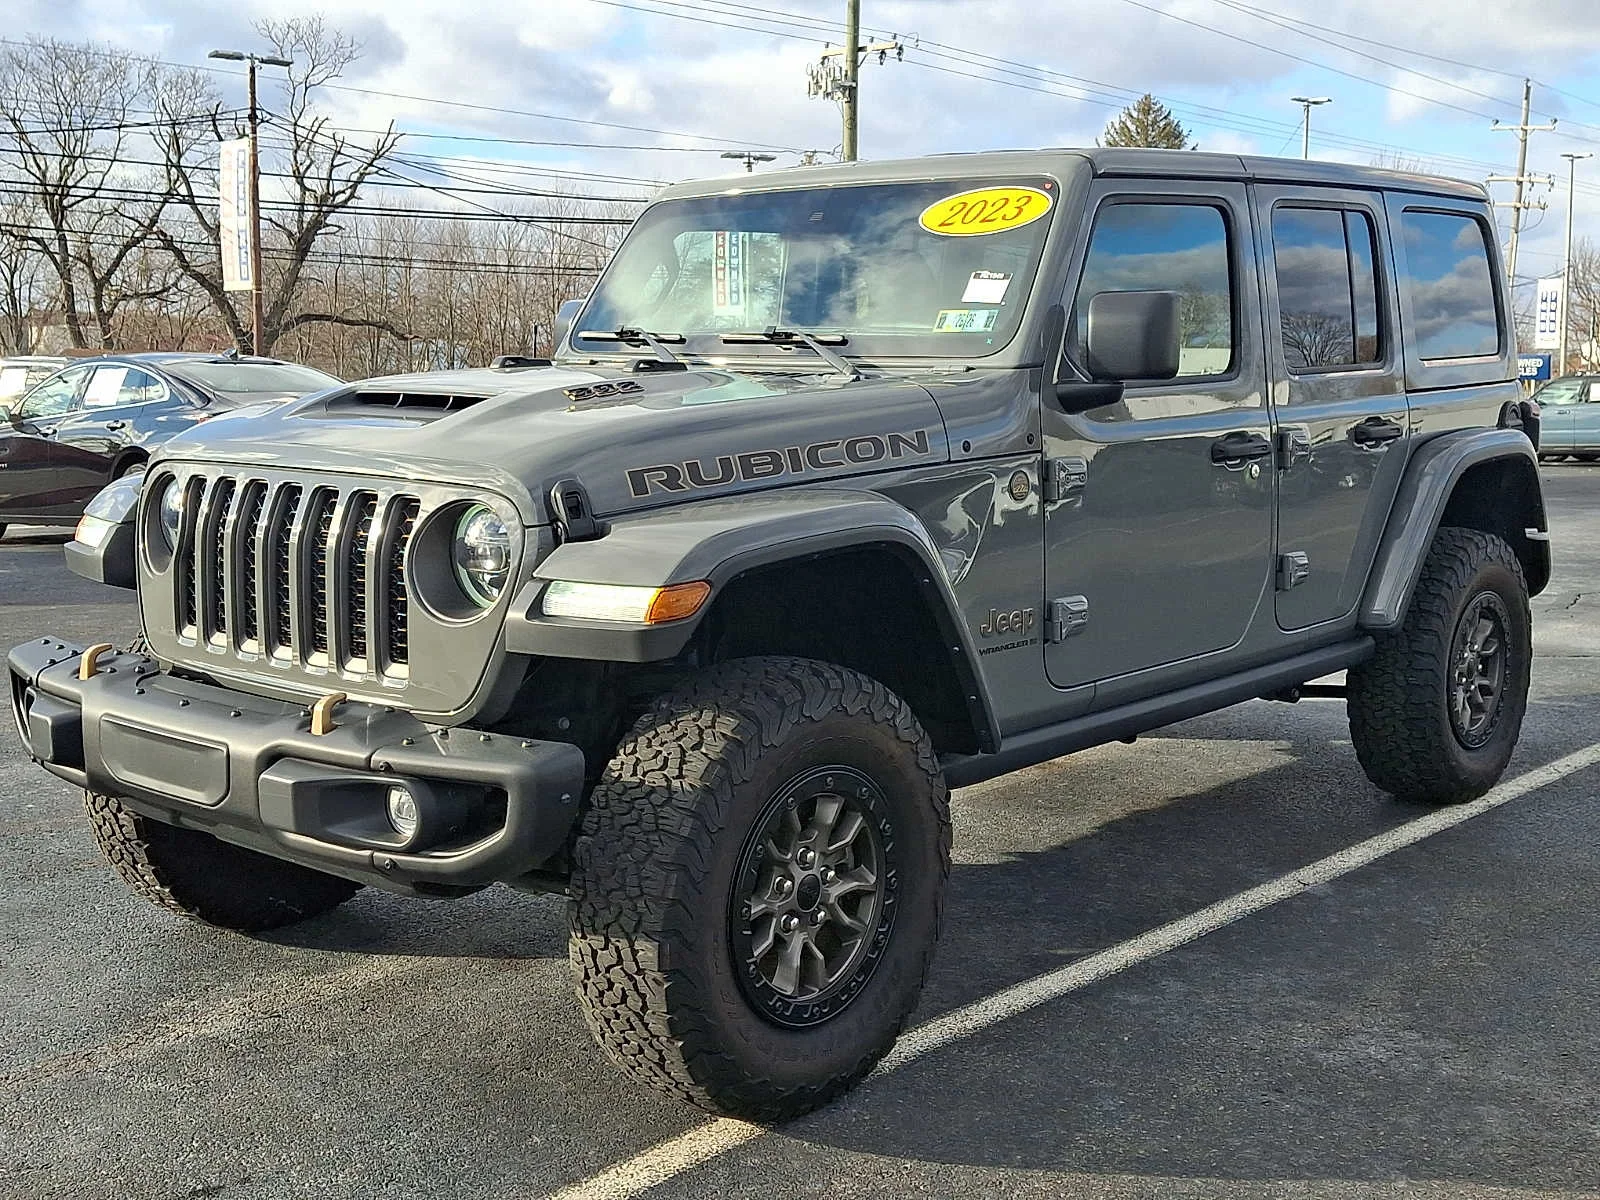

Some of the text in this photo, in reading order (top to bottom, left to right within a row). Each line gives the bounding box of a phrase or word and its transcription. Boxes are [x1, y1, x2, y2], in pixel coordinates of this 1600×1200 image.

[938, 195, 1032, 227] 2023
[625, 430, 930, 498] RUBICON
[980, 607, 1034, 638] Jeep
[978, 639, 1029, 656] WRANGLER
